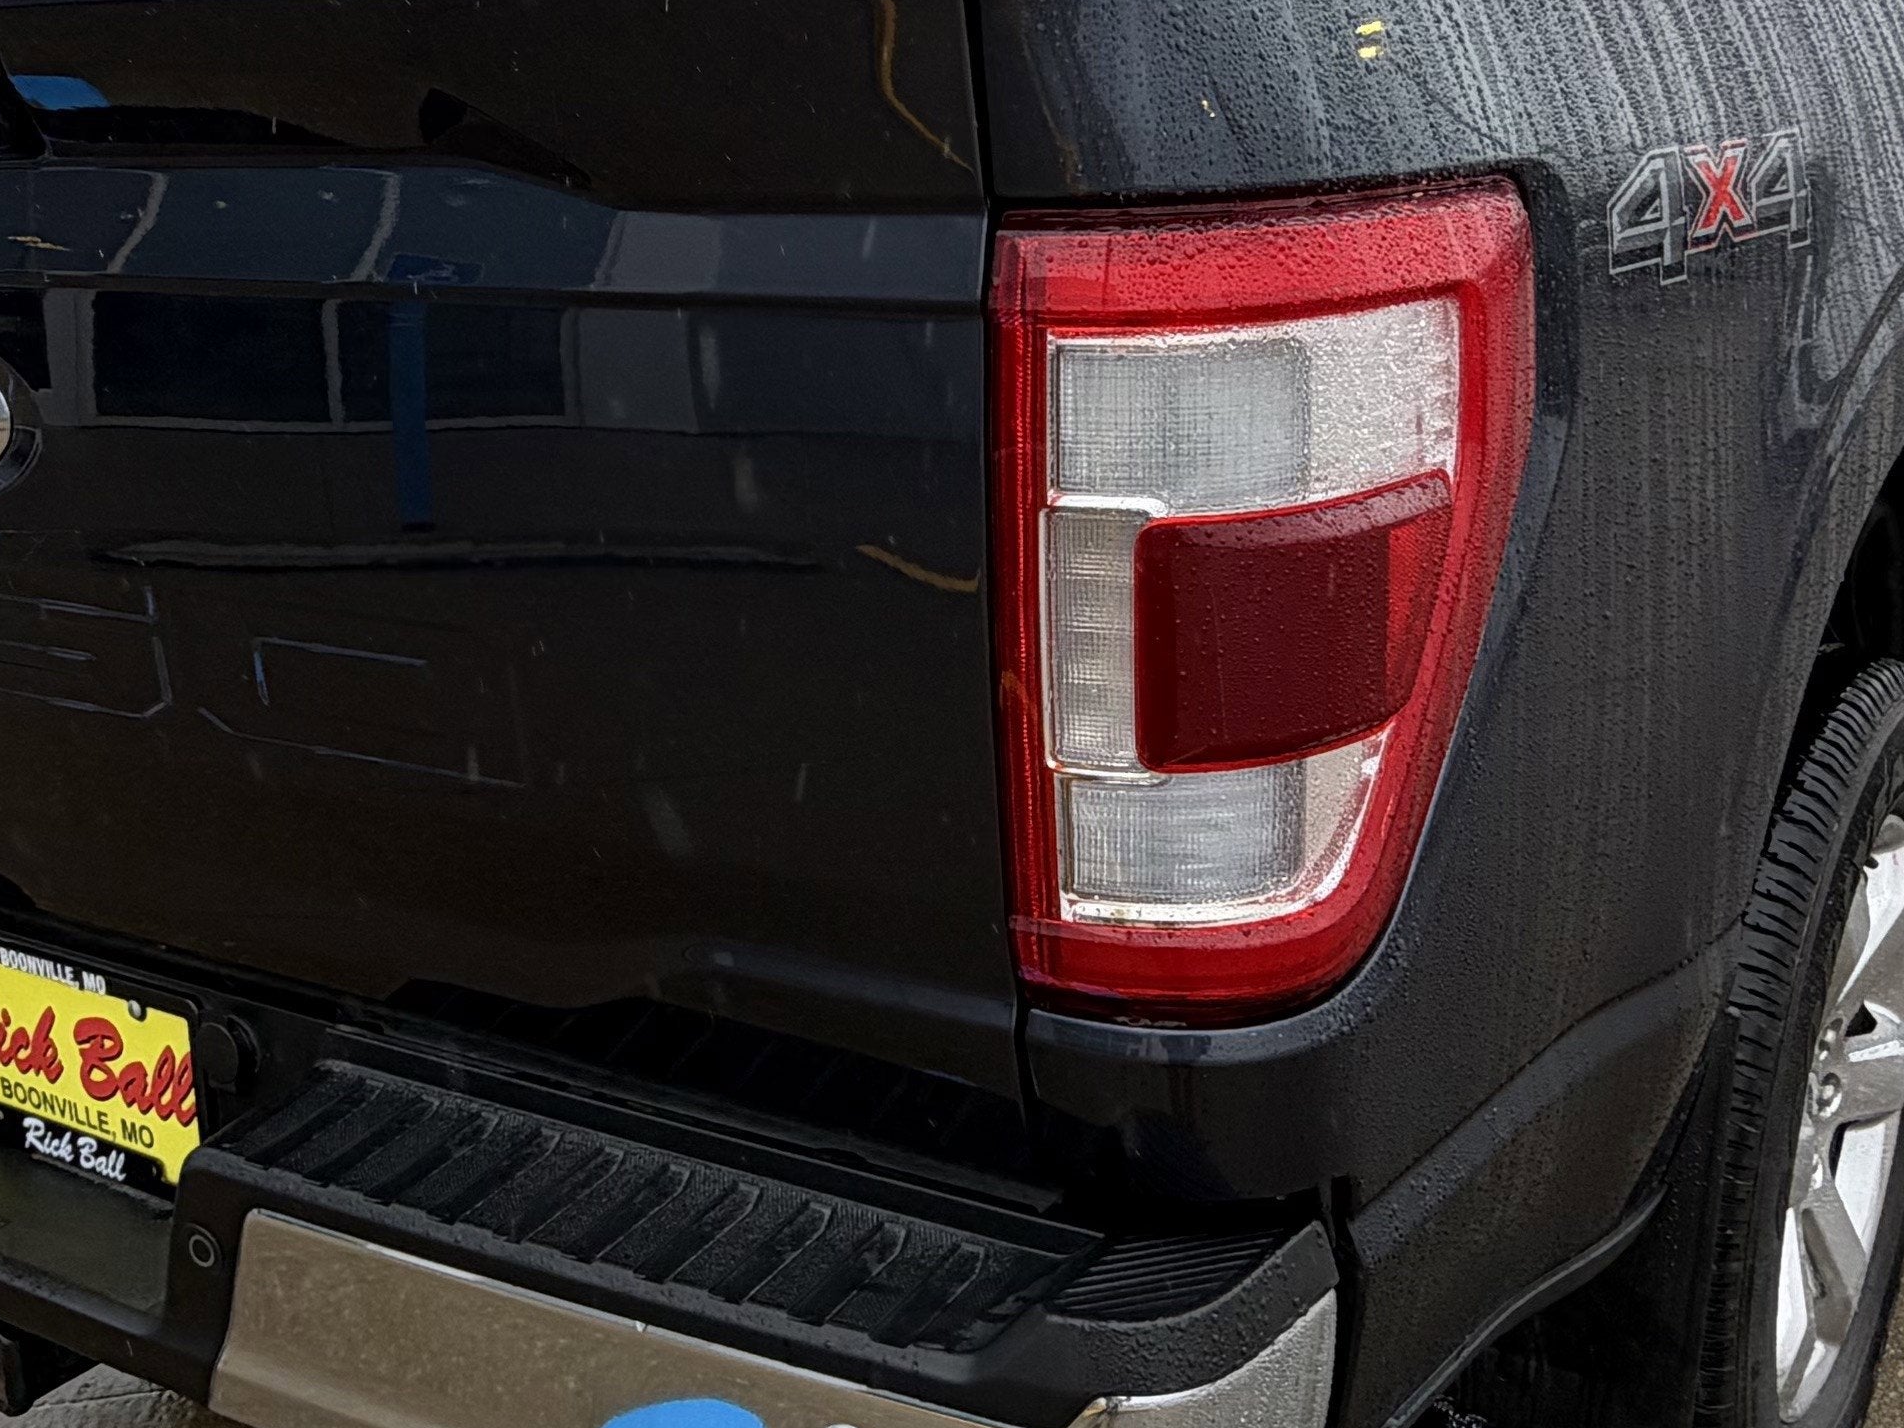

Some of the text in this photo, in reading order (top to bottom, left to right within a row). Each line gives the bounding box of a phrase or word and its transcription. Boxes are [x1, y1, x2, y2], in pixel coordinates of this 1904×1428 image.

[0, 946, 107, 996] BOONVILLE, MO
[73, 1016, 197, 1128] Ball
[0, 1076, 154, 1149] BOONVILLE, MO
[22, 1117, 127, 1182] Rick Ball
